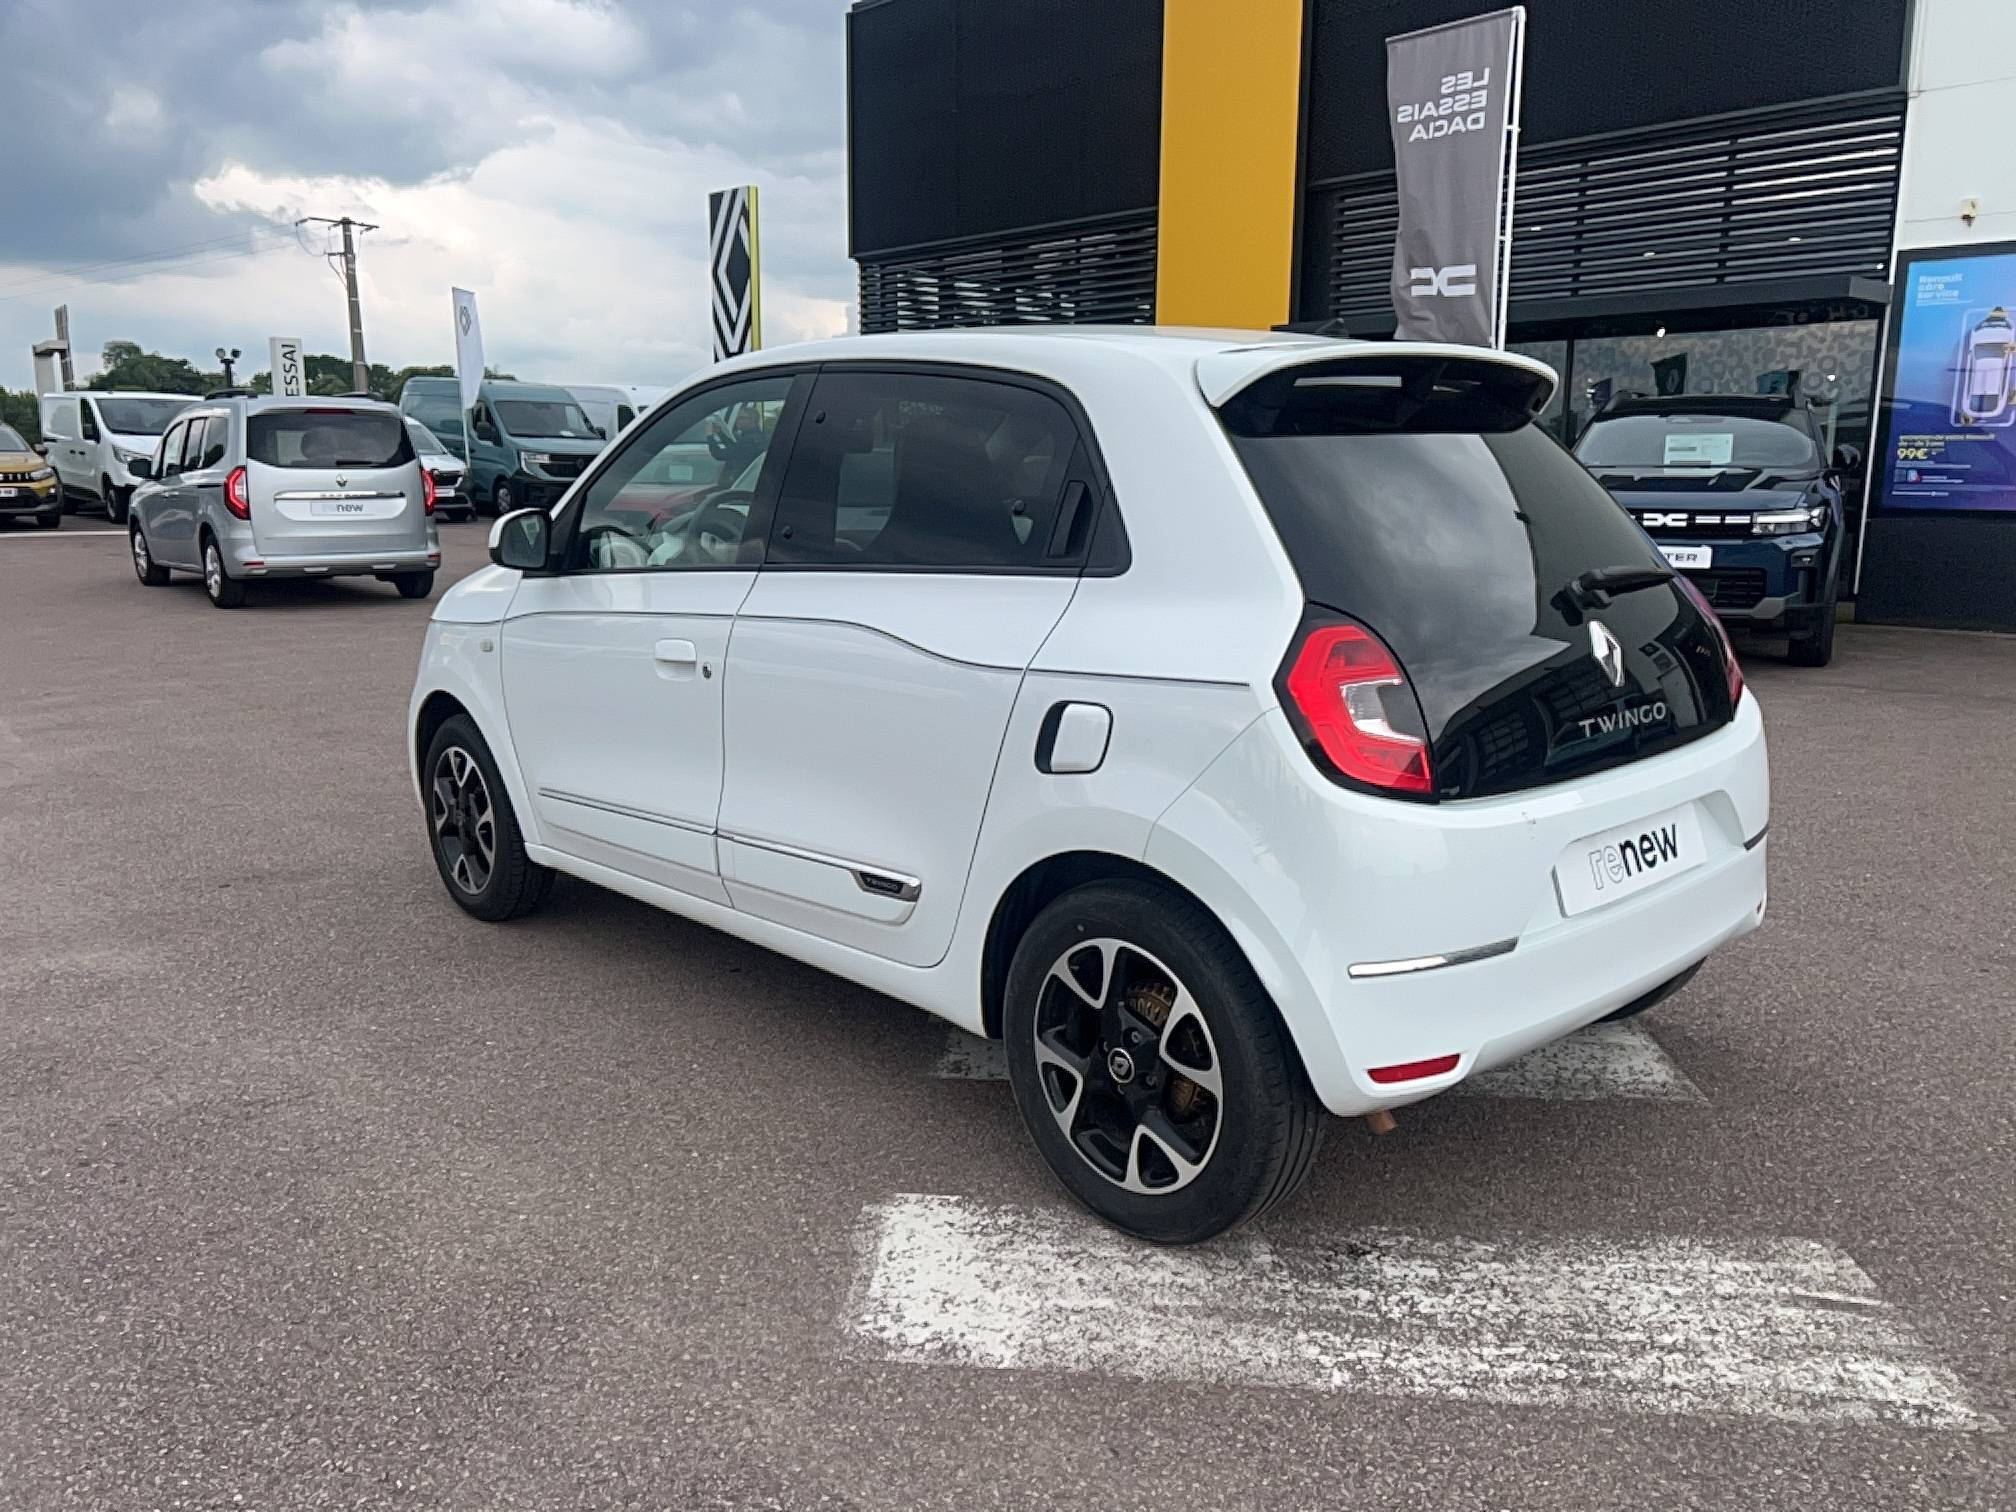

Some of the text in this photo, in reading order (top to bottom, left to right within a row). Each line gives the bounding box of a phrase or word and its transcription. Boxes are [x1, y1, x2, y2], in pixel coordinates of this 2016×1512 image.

[281, 344, 300, 396] ESSAI
[1665, 552, 1698, 561] TER
[1578, 702, 1667, 738] TWINGO
[1588, 823, 1678, 891] renew
